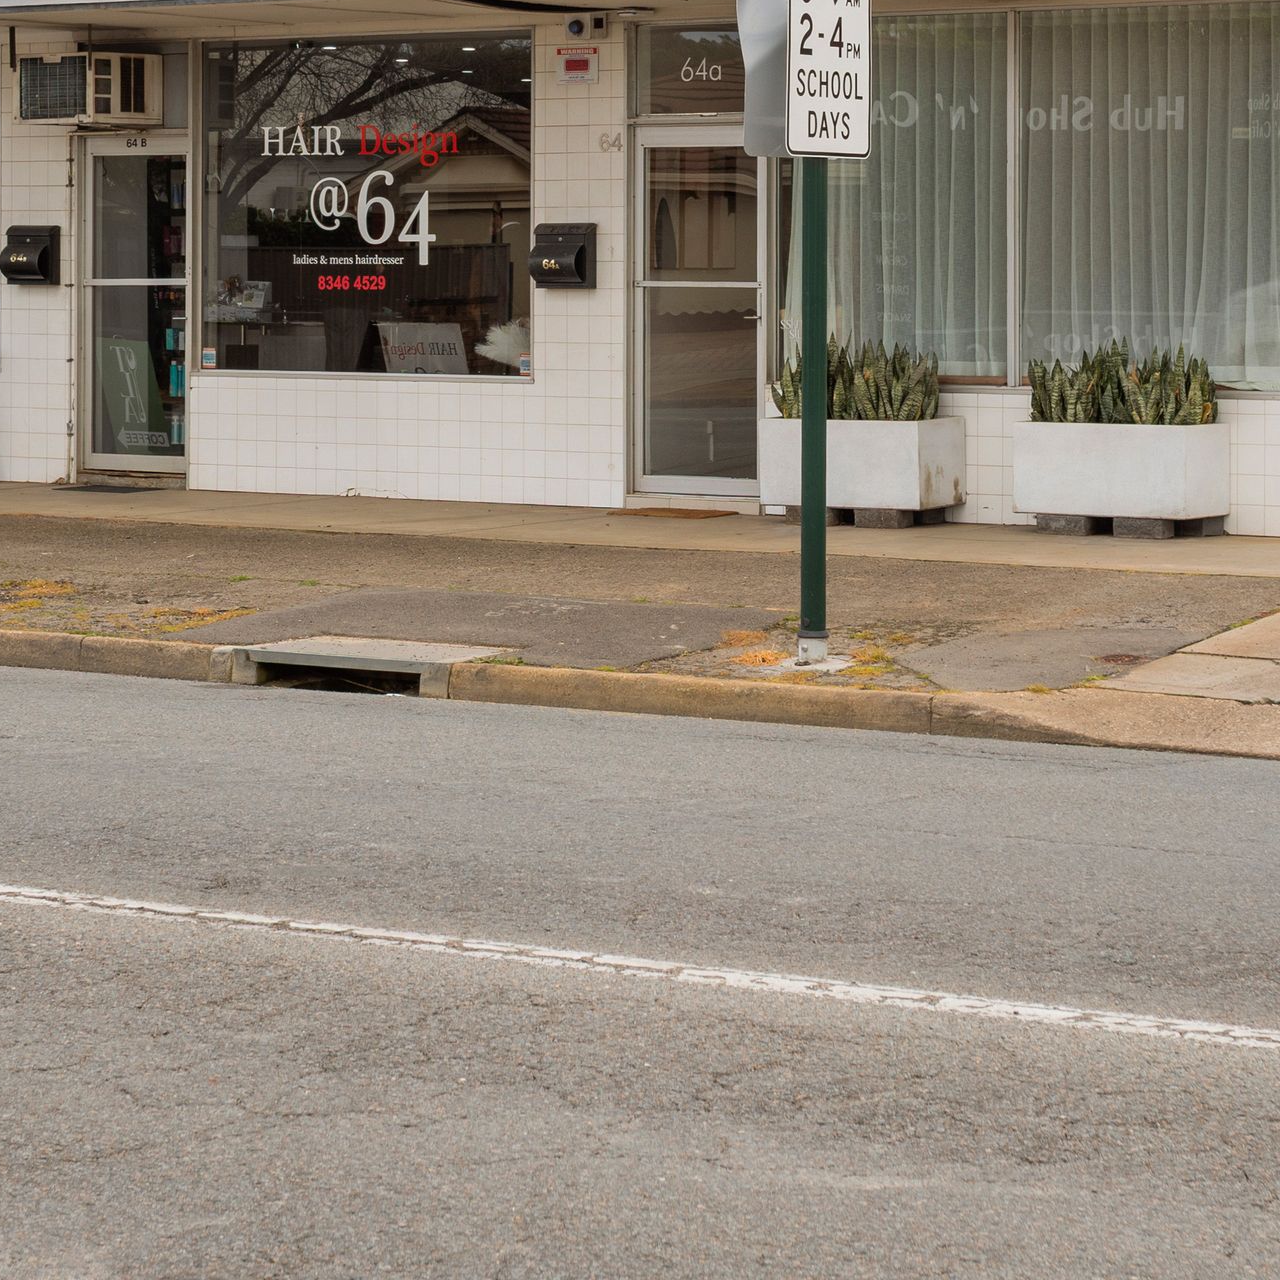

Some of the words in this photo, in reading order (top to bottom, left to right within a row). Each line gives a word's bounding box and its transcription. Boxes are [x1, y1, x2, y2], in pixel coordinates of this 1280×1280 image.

[846, 42, 861, 59] PM
[680, 57, 722, 82] 64a
[796, 68, 863, 100] SCHOOL
[808, 110, 850, 140] DAYS
[126, 138, 137, 148] 64
[141, 138, 147, 147] B
[261, 125, 344, 156] HAIR
[356, 123, 459, 167] Design
[600, 133, 623, 152] 64
[293, 254, 318, 265] ladies
[320, 255, 328, 264] &
[329, 256, 354, 265] mens
[355, 254, 404, 265] hairdresser
[318, 275, 350, 291] 8346
[354, 275, 387, 291] 4529
